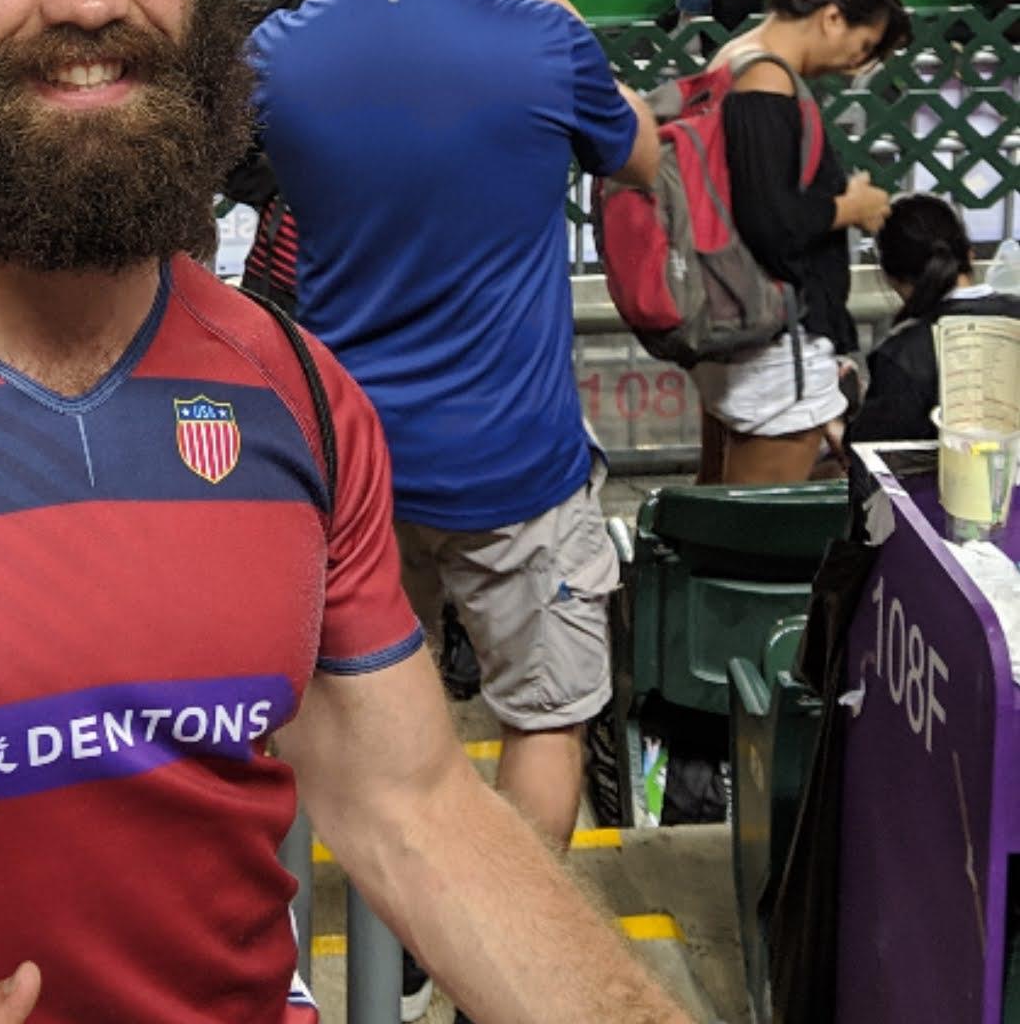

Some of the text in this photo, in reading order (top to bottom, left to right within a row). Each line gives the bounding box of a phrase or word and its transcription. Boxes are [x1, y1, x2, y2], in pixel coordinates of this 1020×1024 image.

[193, 405, 216, 418] USA
[579, 371, 687, 420] 108
[872, 576, 949, 753] 108F
[27, 700, 272, 767] DENTONS
